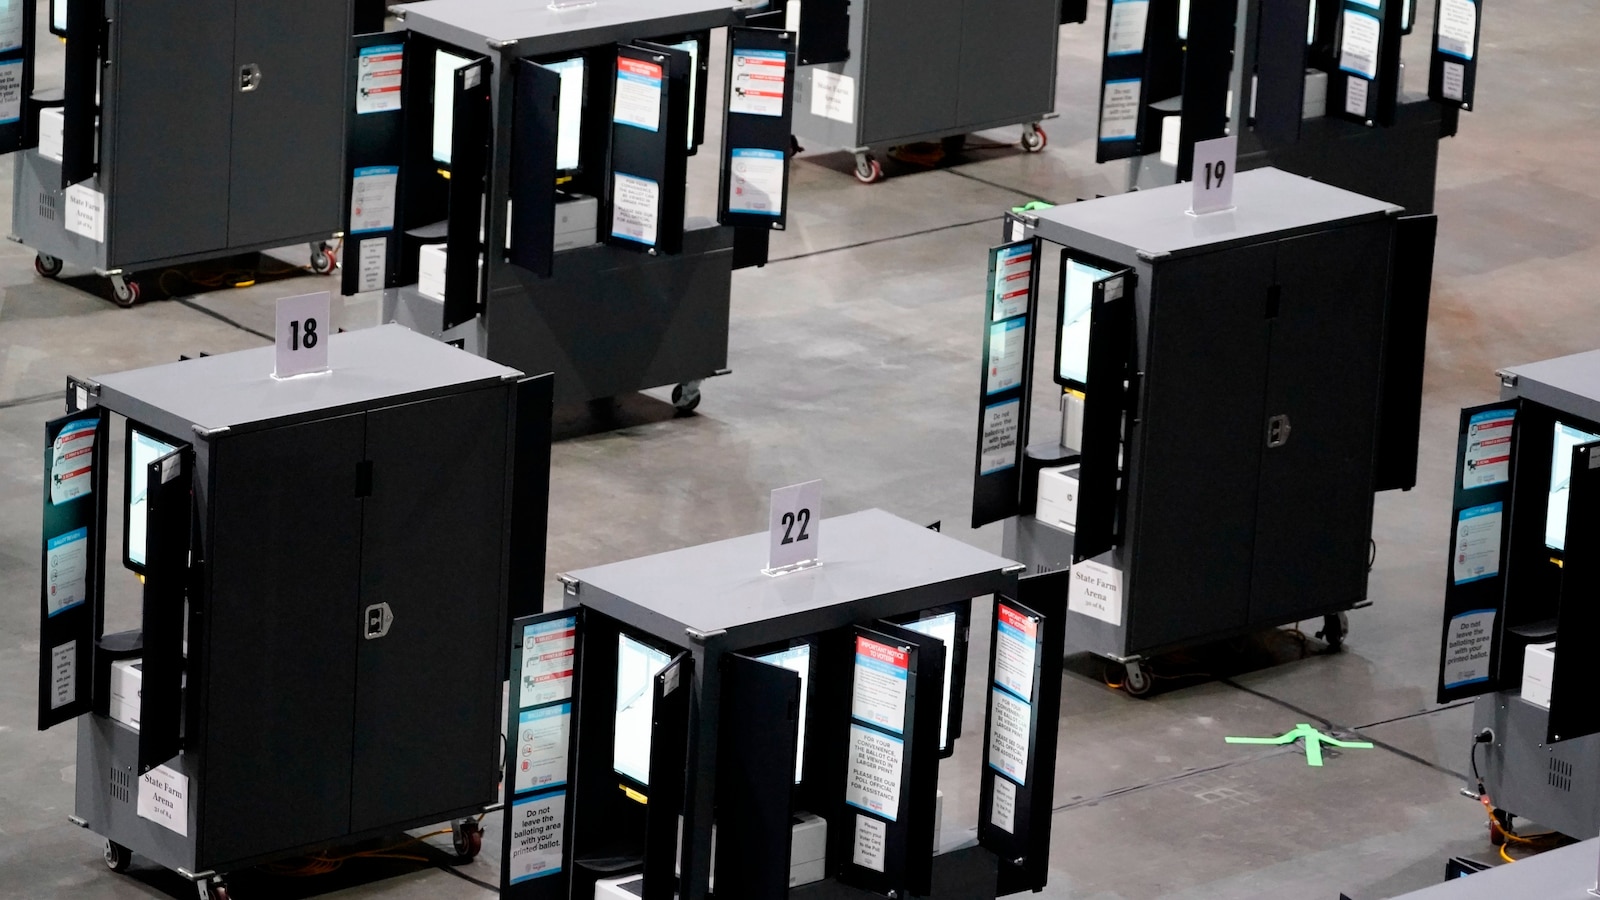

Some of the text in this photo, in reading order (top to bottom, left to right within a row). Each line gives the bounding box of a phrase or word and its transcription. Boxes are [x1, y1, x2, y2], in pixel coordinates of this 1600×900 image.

[1206, 160, 1225, 190] 19
[291, 318, 318, 351] 18
[781, 508, 810, 545] 22
[1076, 571, 1116, 591] State Farm
[1085, 587, 1106, 601] Arena
[861, 641, 904, 660] IMPORTANT NOTICE
[1449, 639, 1475, 648] balloting
[1469, 645, 1482, 653] your
[877, 652, 894, 663] VOTERS
[1448, 655, 1469, 665] printed
[864, 735, 890, 748] FOR YOUR
[866, 748, 886, 759] BALLOT
[887, 755, 898, 764] CAN
[867, 755, 886, 766] VIEWED
[856, 758, 876, 770] LARGER
[853, 769, 895, 787] PLEASE SEE OUR
[856, 776, 891, 792] POLL OFFICIAL
[145, 774, 162, 788] State
[164, 783, 182, 799] Farm
[153, 793, 174, 808] Arena
[538, 806, 550, 815] not
[522, 815, 554, 828] leave the
[514, 826, 543, 838] balloting
[521, 834, 553, 846] with your
[513, 839, 560, 857] printed ballot.
